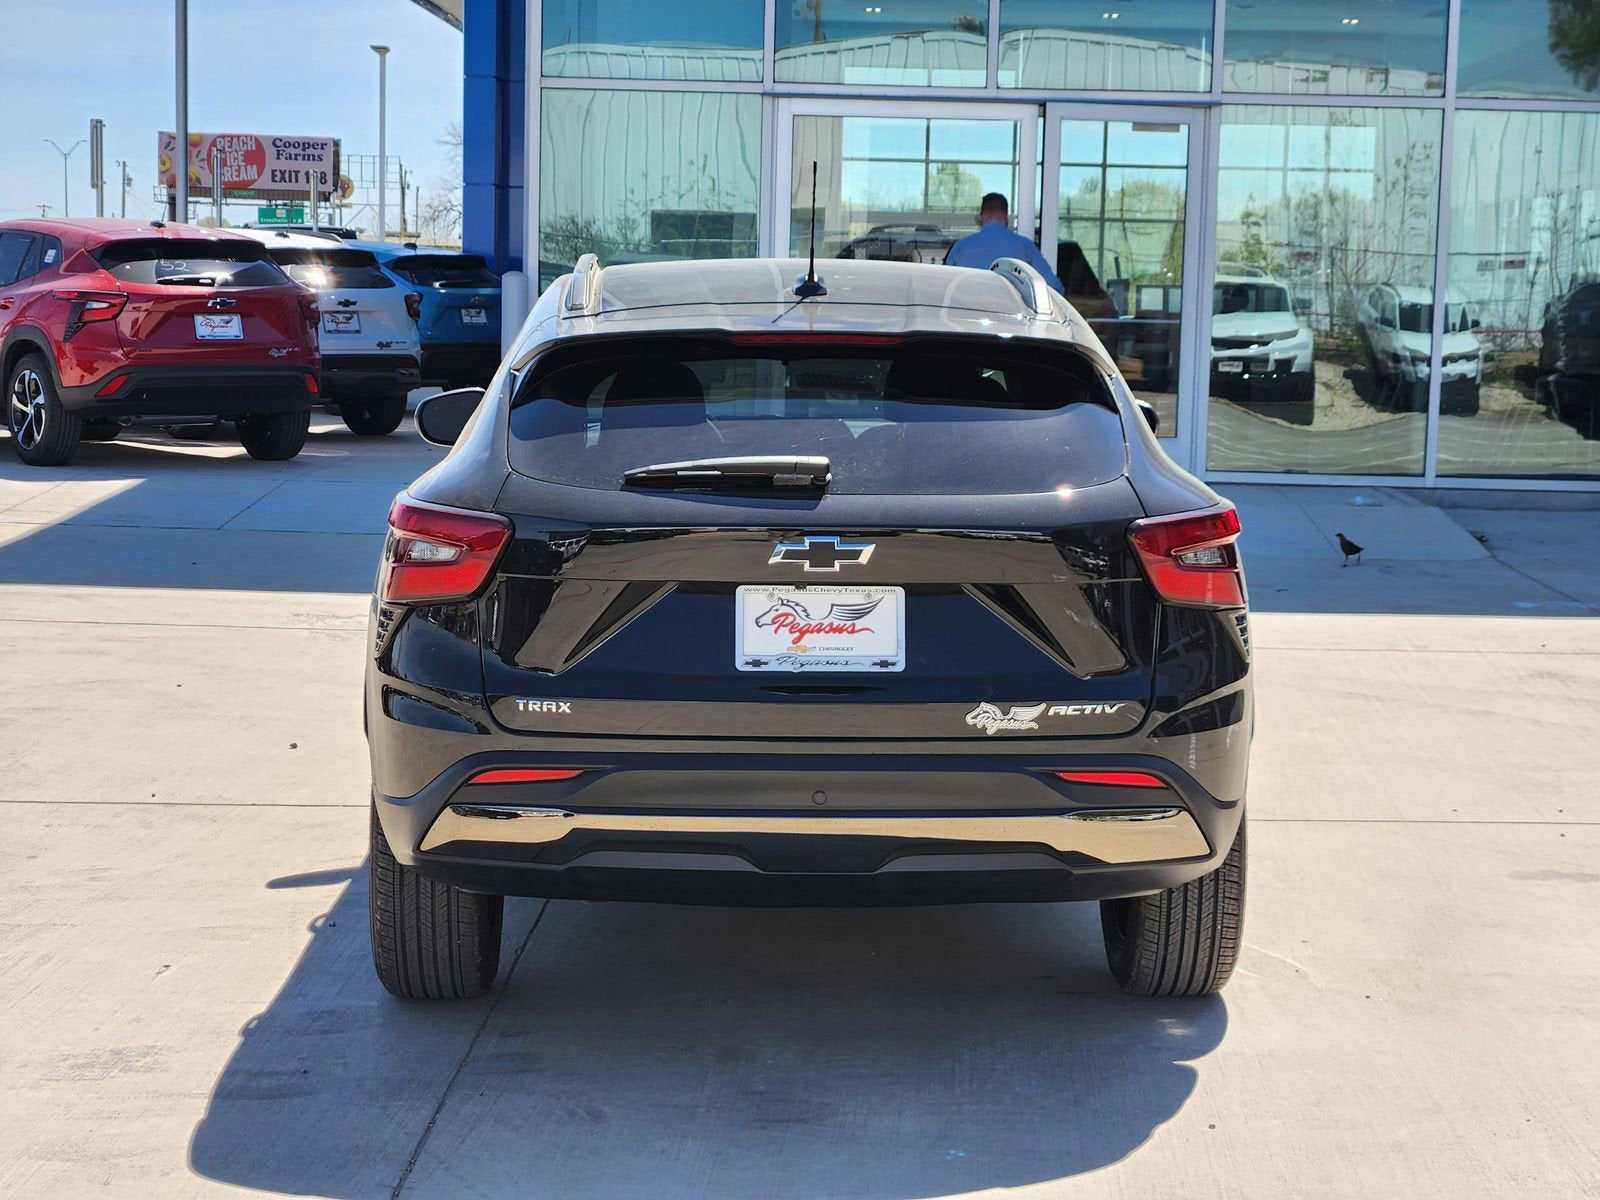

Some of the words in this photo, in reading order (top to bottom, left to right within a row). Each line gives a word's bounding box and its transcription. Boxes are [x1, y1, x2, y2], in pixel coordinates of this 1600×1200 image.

[216, 135, 256, 152] PEACH
[272, 137, 328, 152] Cooper
[275, 149, 324, 162] Farms
[271, 168, 301, 184] EXIT
[304, 170, 328, 185] 18
[771, 611, 875, 645] Pegasus
[776, 655, 867, 671] Pegasus
[515, 699, 572, 714] TRAX
[1047, 703, 1128, 716] ACTIV
[976, 711, 1039, 735] Pegasus
